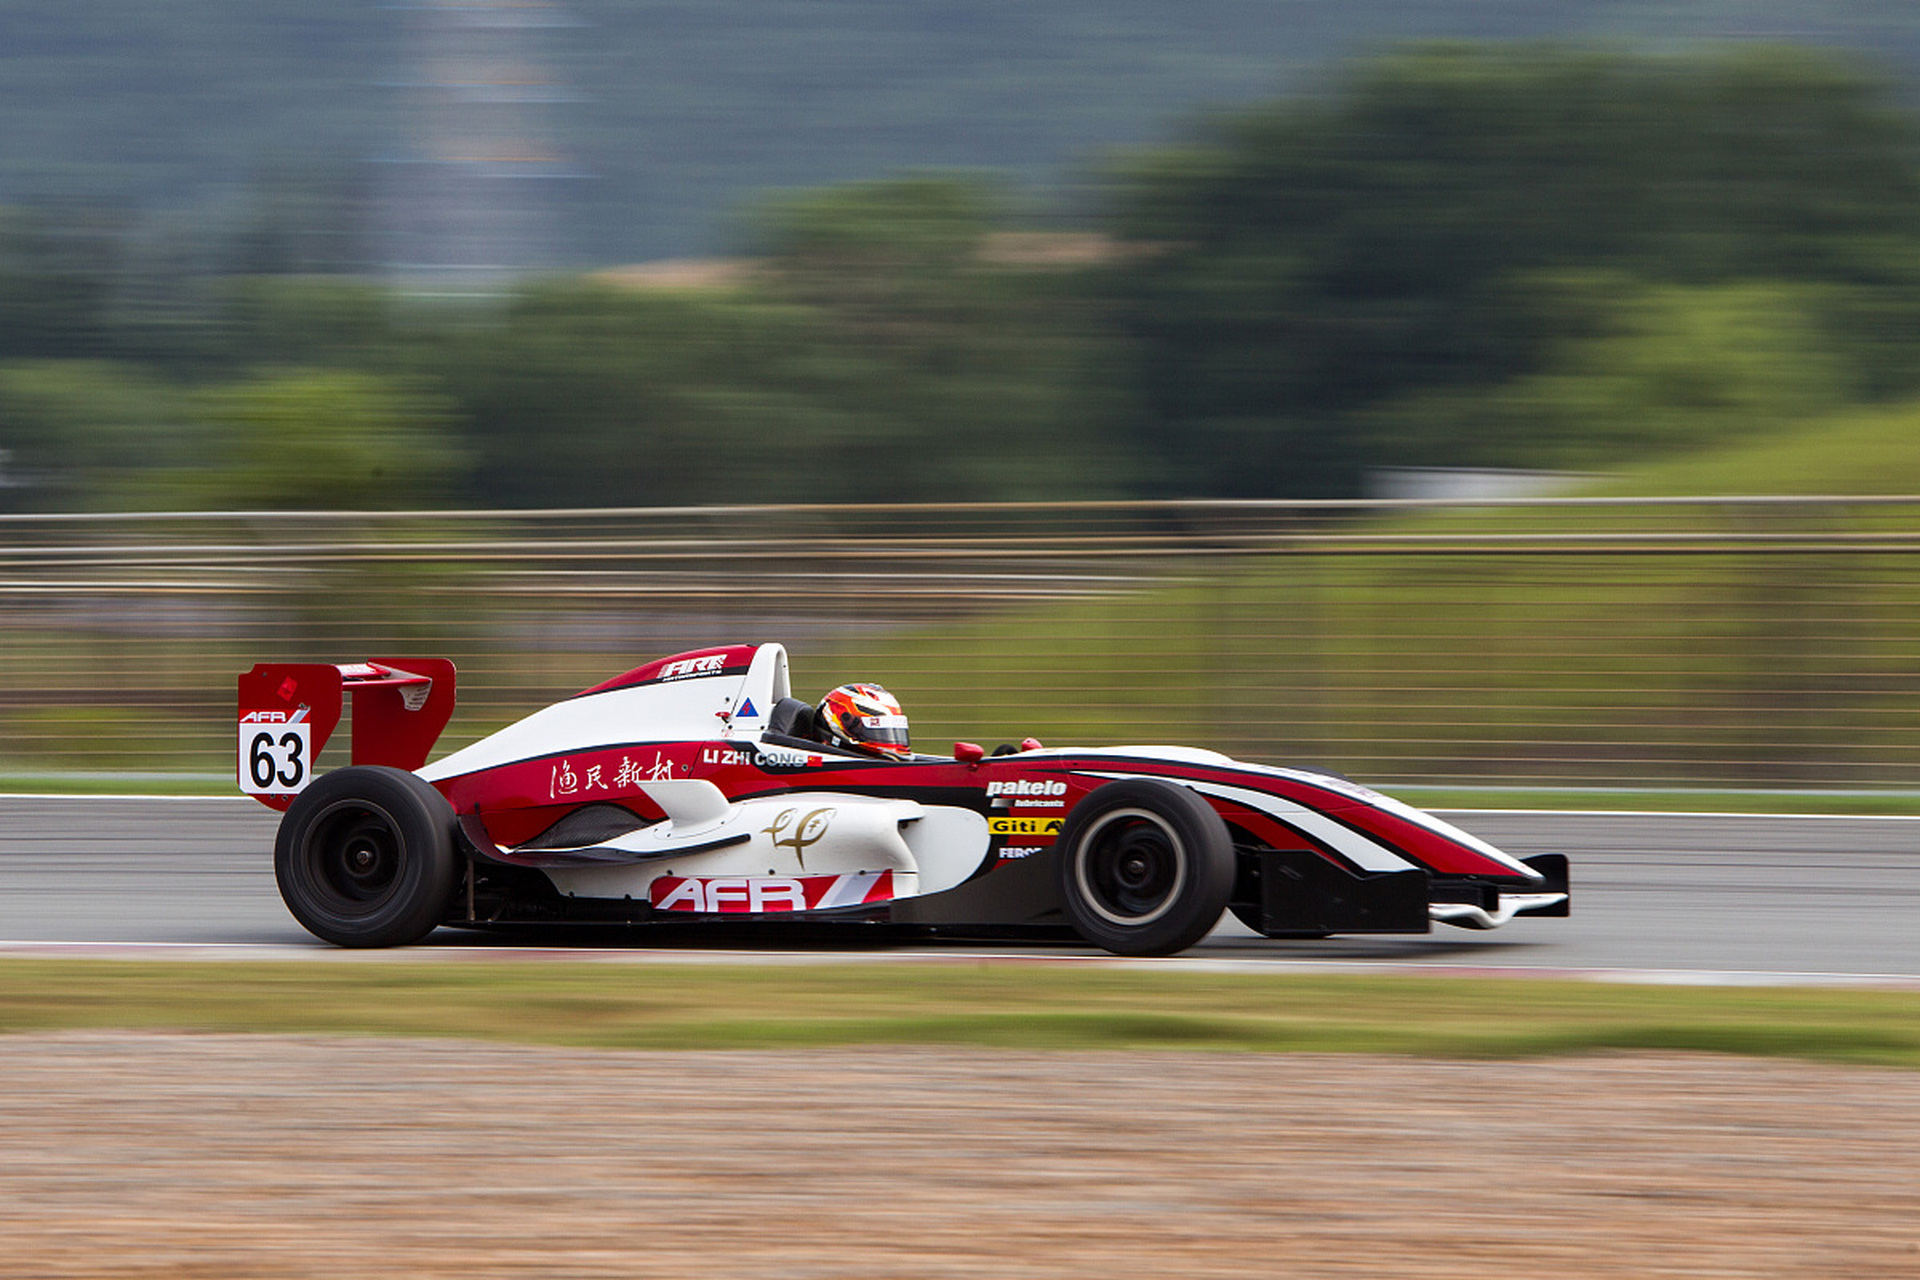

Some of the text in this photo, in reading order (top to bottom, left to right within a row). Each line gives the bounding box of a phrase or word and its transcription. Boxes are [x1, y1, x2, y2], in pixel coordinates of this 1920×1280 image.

[240, 711, 287, 723] AFR
[250, 732, 304, 788] 63
[703, 749, 805, 768] LI ZHI CONG
[986, 779, 1067, 797] pakelo
[993, 820, 1036, 832] Giti
[655, 877, 807, 913] AFR
